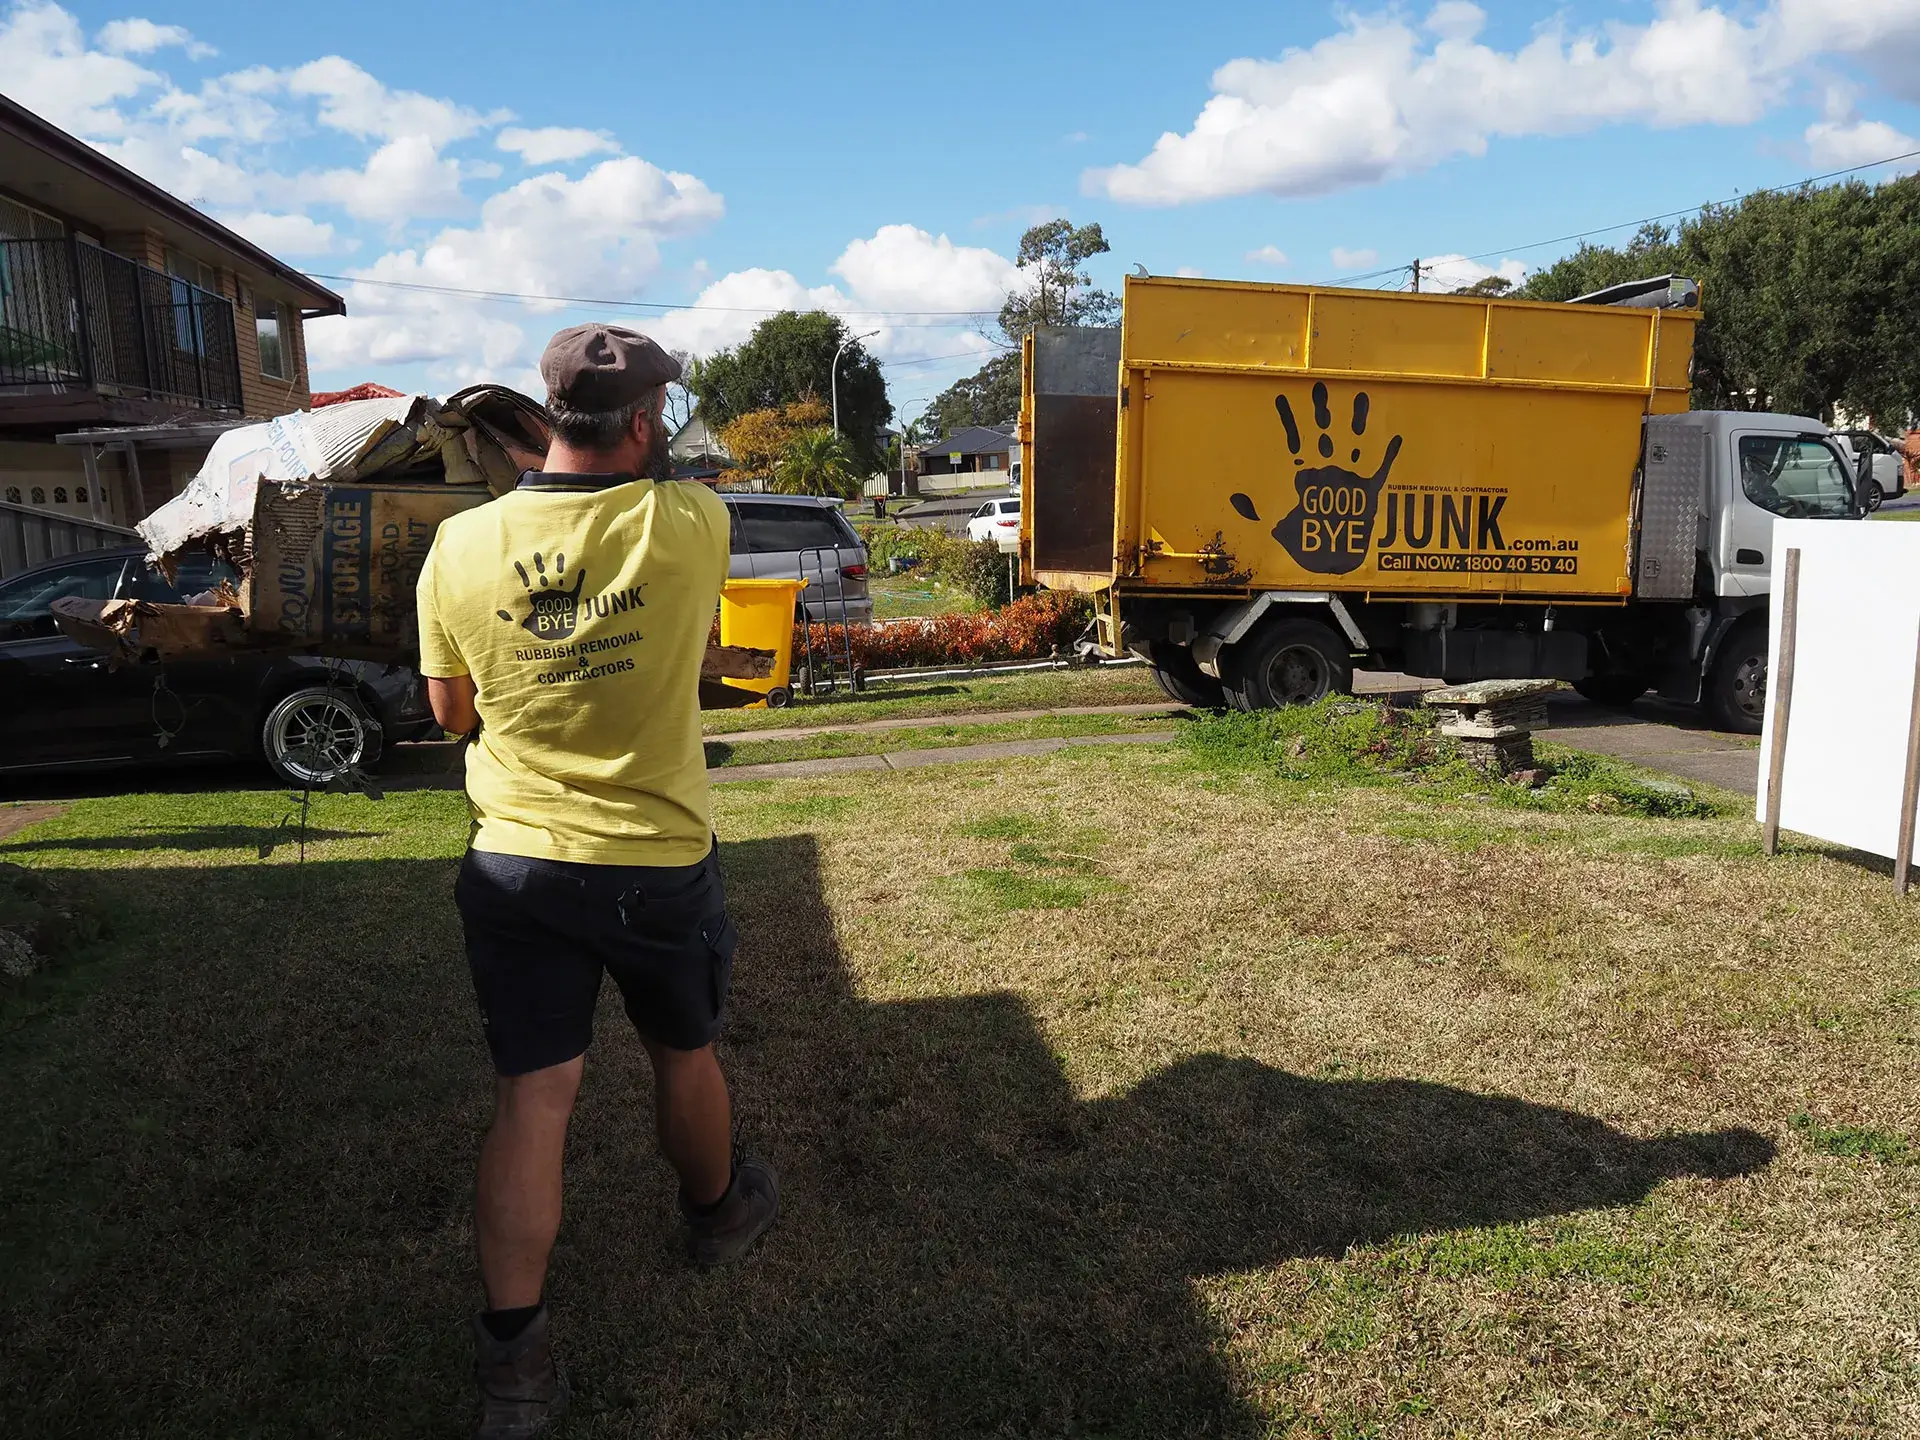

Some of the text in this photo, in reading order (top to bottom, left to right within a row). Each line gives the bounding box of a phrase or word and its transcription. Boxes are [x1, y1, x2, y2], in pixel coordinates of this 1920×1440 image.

[1303, 485, 1367, 516] GOOD
[1460, 486, 1509, 494] CONTRACTORS
[1301, 518, 1365, 553] BYE
[332, 501, 362, 625] STORAGE
[380, 523, 400, 585] ROAD
[1381, 554, 1575, 572] Call NOW: 1800 40 50 40
[536, 596, 573, 614] GOOD
[537, 612, 576, 632] BYE
[515, 630, 644, 662] RUBBISH REMOVAL
[537, 658, 635, 685] CONTRACTORS
[578, 656, 590, 668] &
